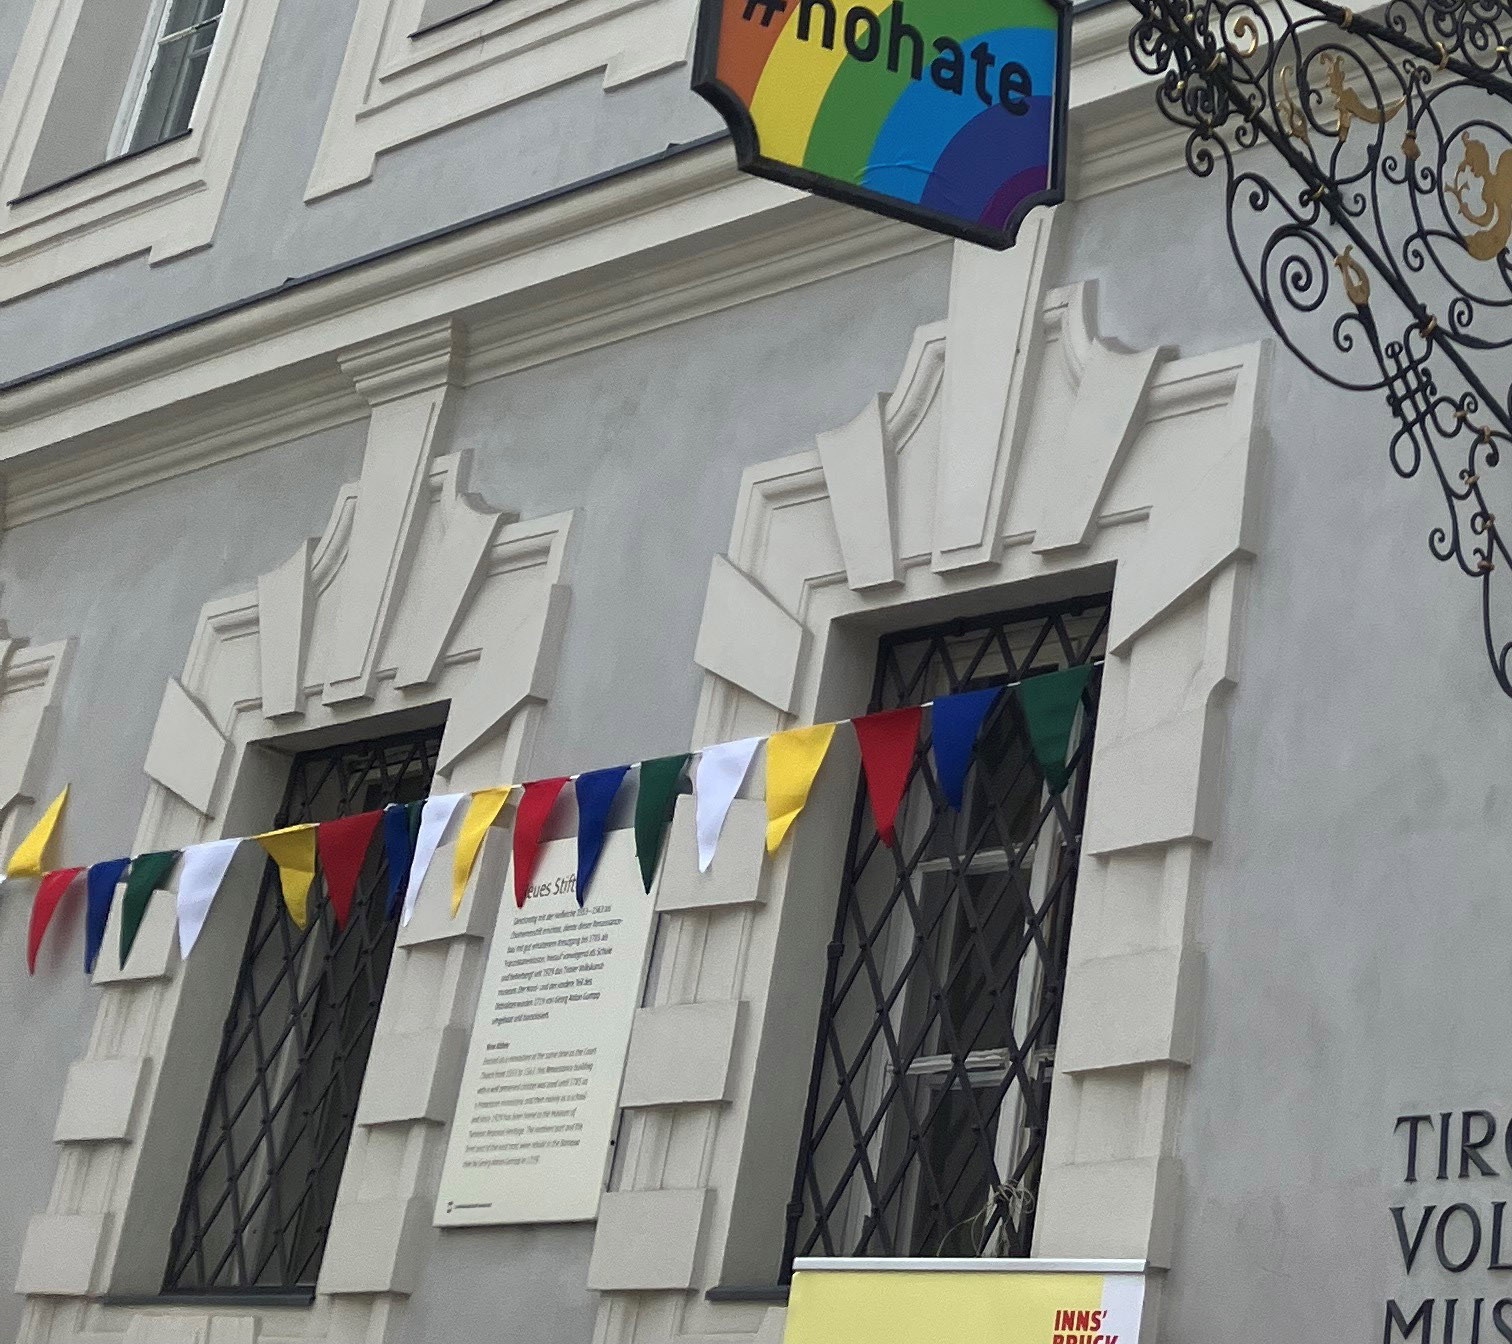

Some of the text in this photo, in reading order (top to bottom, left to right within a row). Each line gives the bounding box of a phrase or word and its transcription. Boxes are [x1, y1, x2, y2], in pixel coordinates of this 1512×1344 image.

[525, 873, 576, 899] eues Stift
[1054, 1309, 1108, 1332] INNS'
